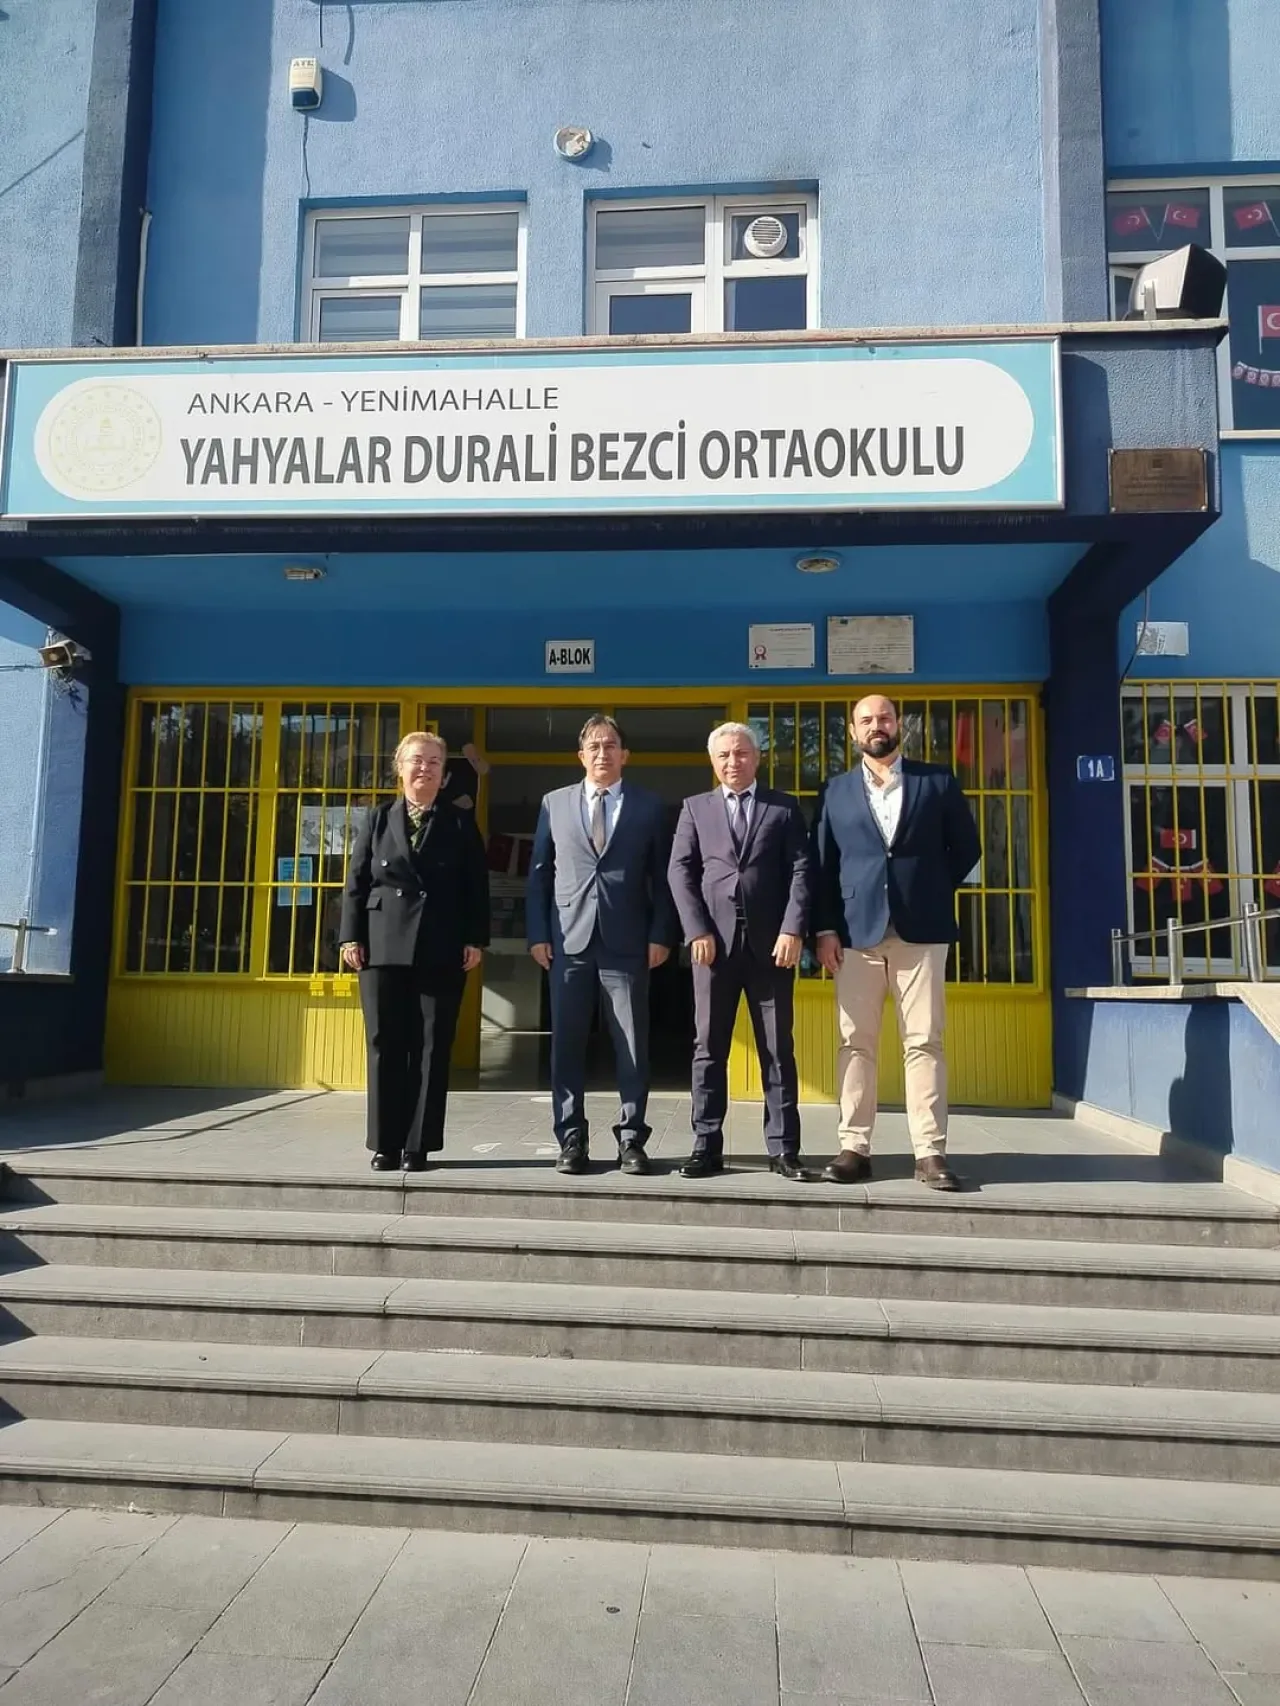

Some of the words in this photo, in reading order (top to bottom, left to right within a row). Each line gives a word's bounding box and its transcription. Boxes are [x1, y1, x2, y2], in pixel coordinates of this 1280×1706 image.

[187, 391, 314, 415] ANKARA
[340, 385, 559, 413] YENİMAHALLE
[179, 435, 392, 485] YAHYALAR
[403, 421, 557, 484] DURALİ
[570, 419, 686, 482] BEZCİ
[698, 425, 964, 480] ORTAOKULU
[549, 647, 591, 666] A-BLOK
[1087, 759, 1105, 778] 1A
